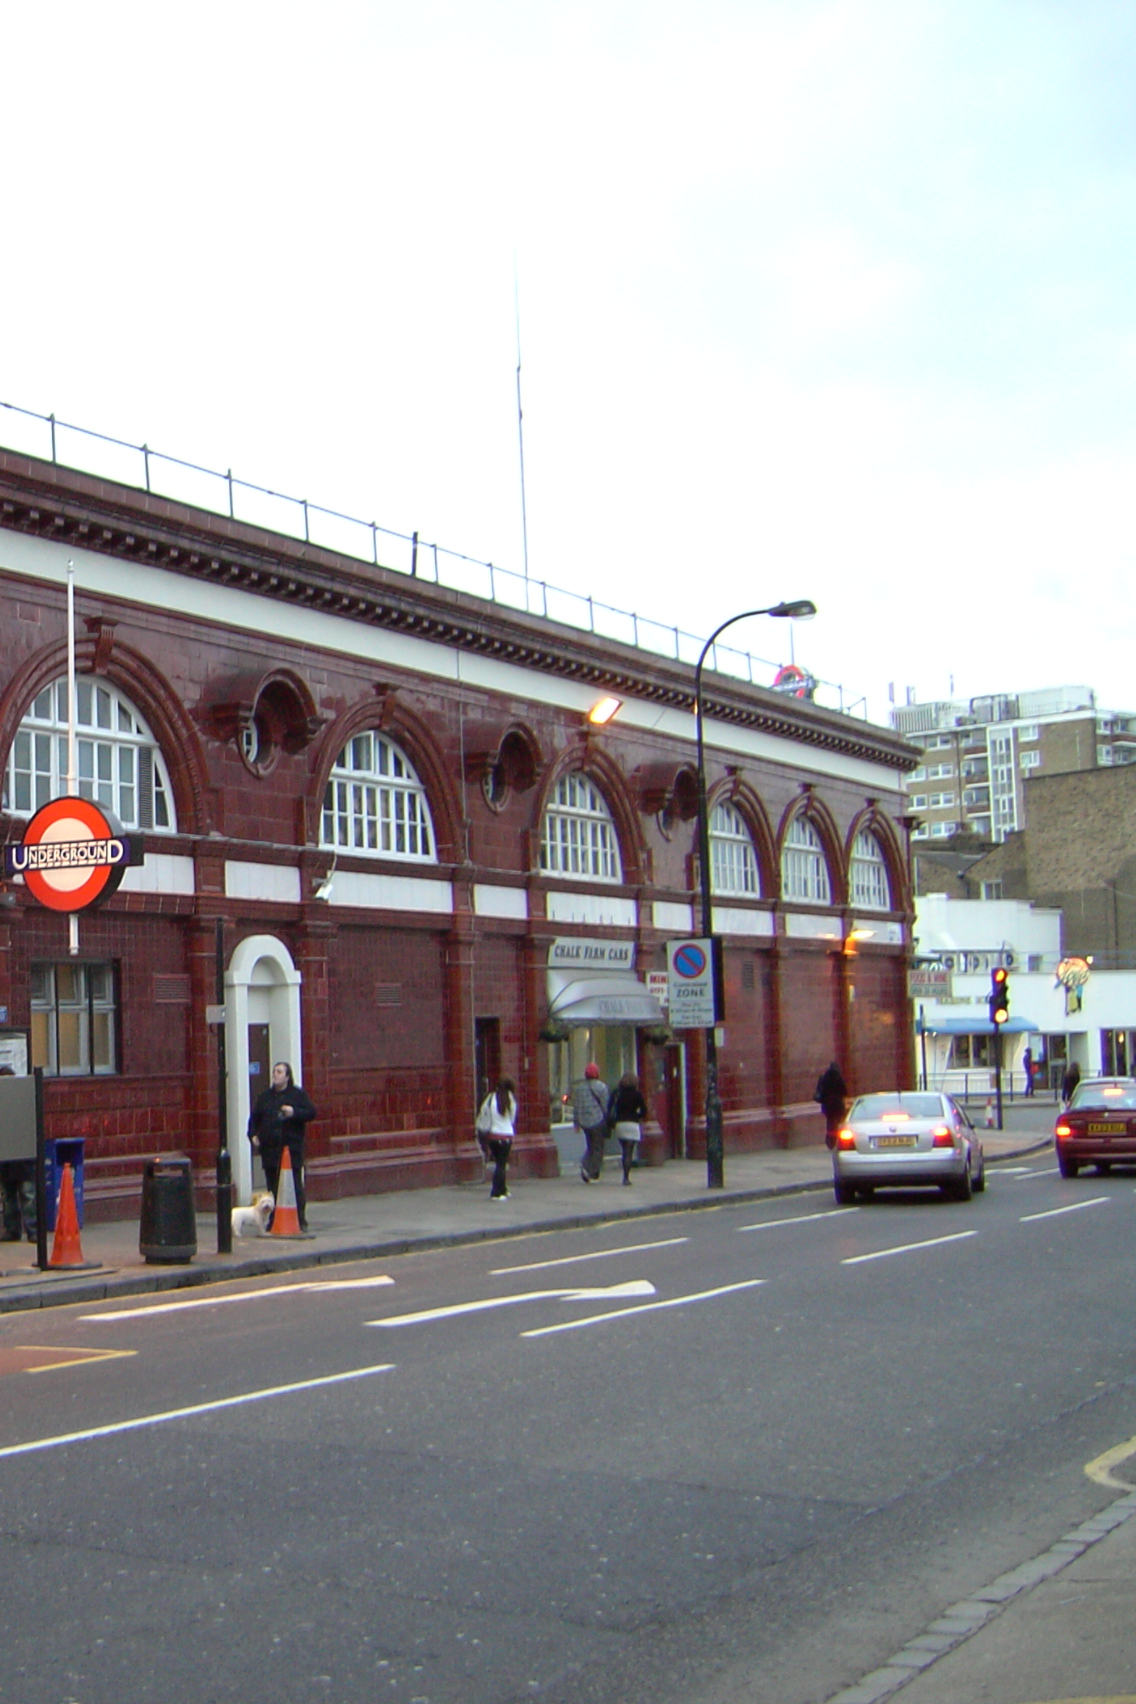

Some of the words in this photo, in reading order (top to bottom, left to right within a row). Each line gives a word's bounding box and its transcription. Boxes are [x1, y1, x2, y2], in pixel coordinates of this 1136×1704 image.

[12, 839, 124, 870] UNDERGROUND
[554, 944, 582, 959] CHALK
[583, 946, 605, 959] FARM
[608, 948, 629, 961] CARS
[676, 989, 706, 998] ZONE
